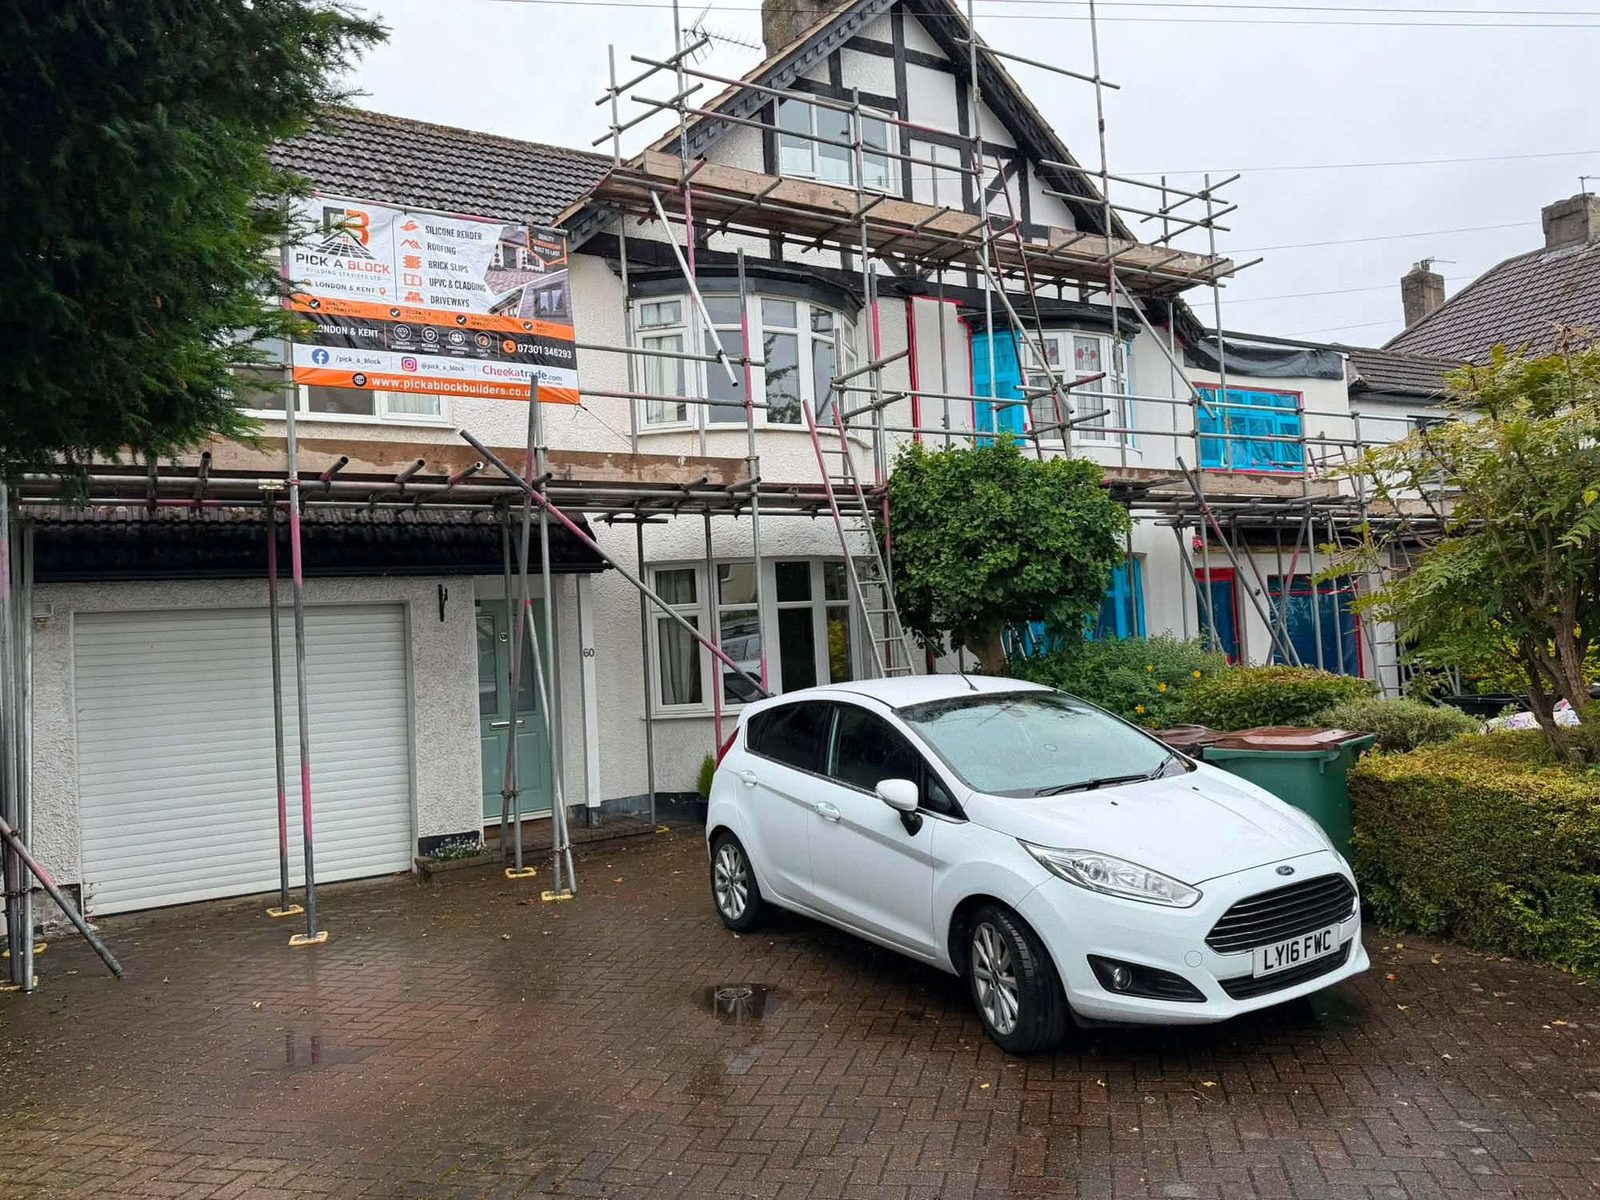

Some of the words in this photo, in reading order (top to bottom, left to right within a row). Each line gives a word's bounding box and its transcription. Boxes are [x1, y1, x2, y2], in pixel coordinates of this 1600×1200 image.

[425, 225, 455, 238] SILICONE
[456, 229, 482, 240] RENDER
[427, 242, 457, 255] ROOFING
[295, 252, 328, 267] PICK
[334, 259, 344, 269] A
[347, 260, 391, 274] BLOCK
[428, 260, 448, 271] BRICK
[450, 263, 468, 273] SLIPS
[315, 281, 347, 290] LONDON
[356, 285, 375, 294] KENT
[429, 277, 447, 288] UPVC
[448, 279, 453, 288] &
[454, 280, 487, 293] CLADDING
[430, 295, 470, 308] DRIVEWAYS
[350, 328, 356, 336] &
[358, 328, 379, 338] KENT
[517, 343, 543, 354] 07301
[544, 346, 572, 359] 346293
[371, 377, 531, 396] www.pickablockbuilders.co.u
[583, 647, 595, 658] 60
[1264, 940, 1300, 970] LY16
[1304, 930, 1331, 958] FWC
